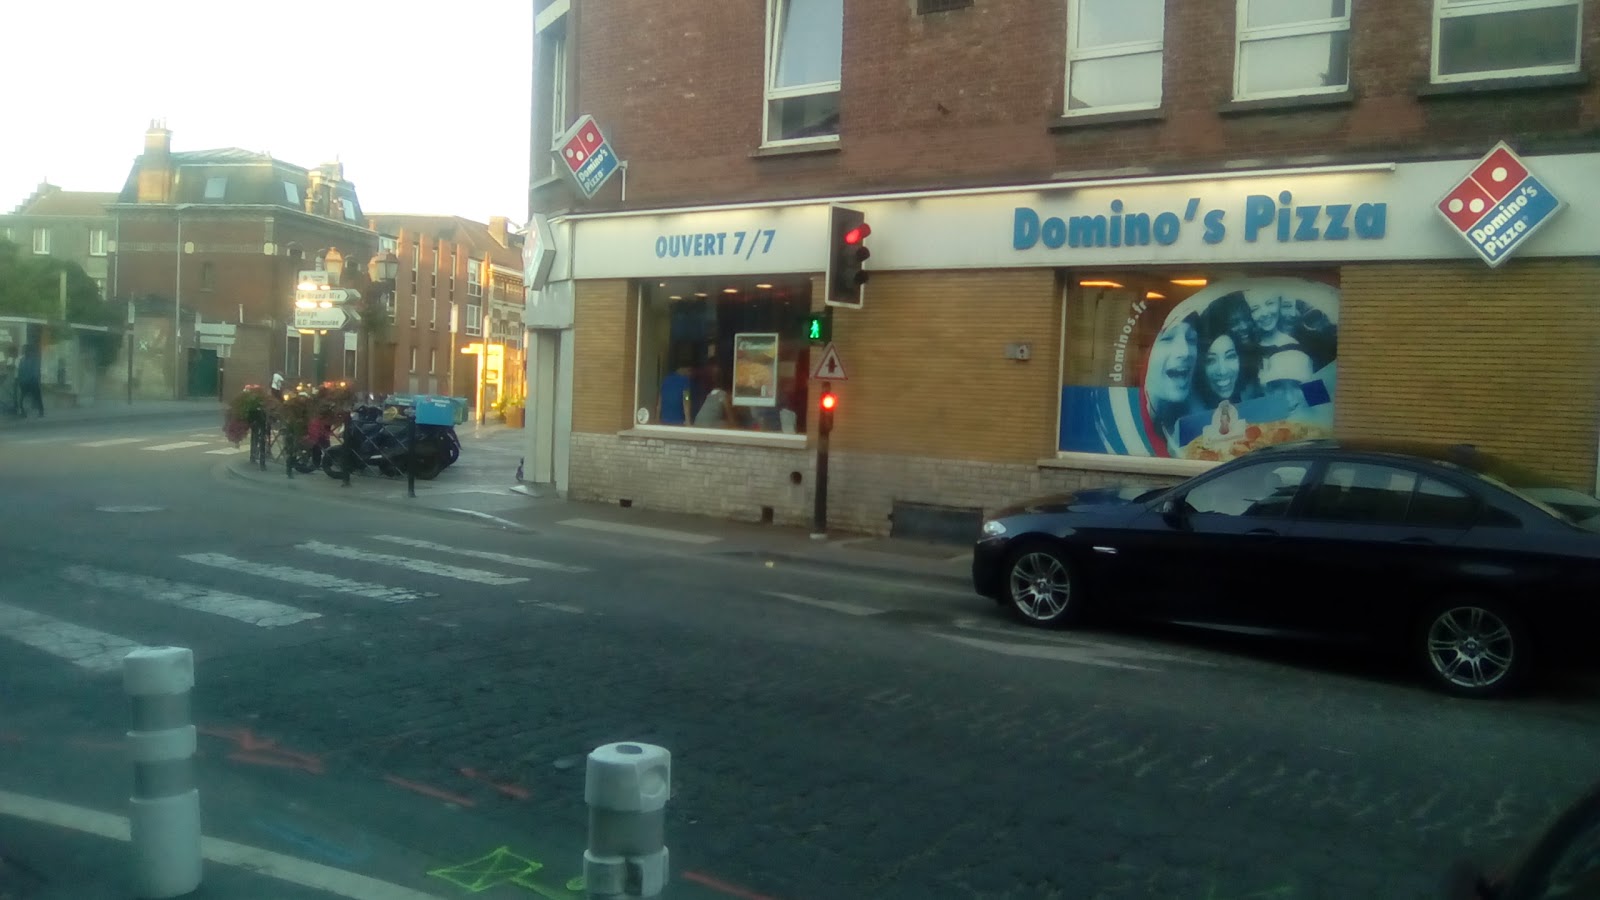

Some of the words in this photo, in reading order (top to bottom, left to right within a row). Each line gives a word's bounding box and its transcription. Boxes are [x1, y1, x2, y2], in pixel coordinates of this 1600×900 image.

[577, 148, 608, 182] Domino's
[583, 170, 604, 192] Pizza
[1013, 198, 1226, 250] Domino's
[1244, 189, 1387, 243] Pizza
[1471, 185, 1538, 244] Domino's
[655, 232, 727, 258] OUVERT
[733, 229, 776, 260] 7/7
[1483, 219, 1528, 257] Pizza
[1109, 301, 1147, 382] dominos.fr
